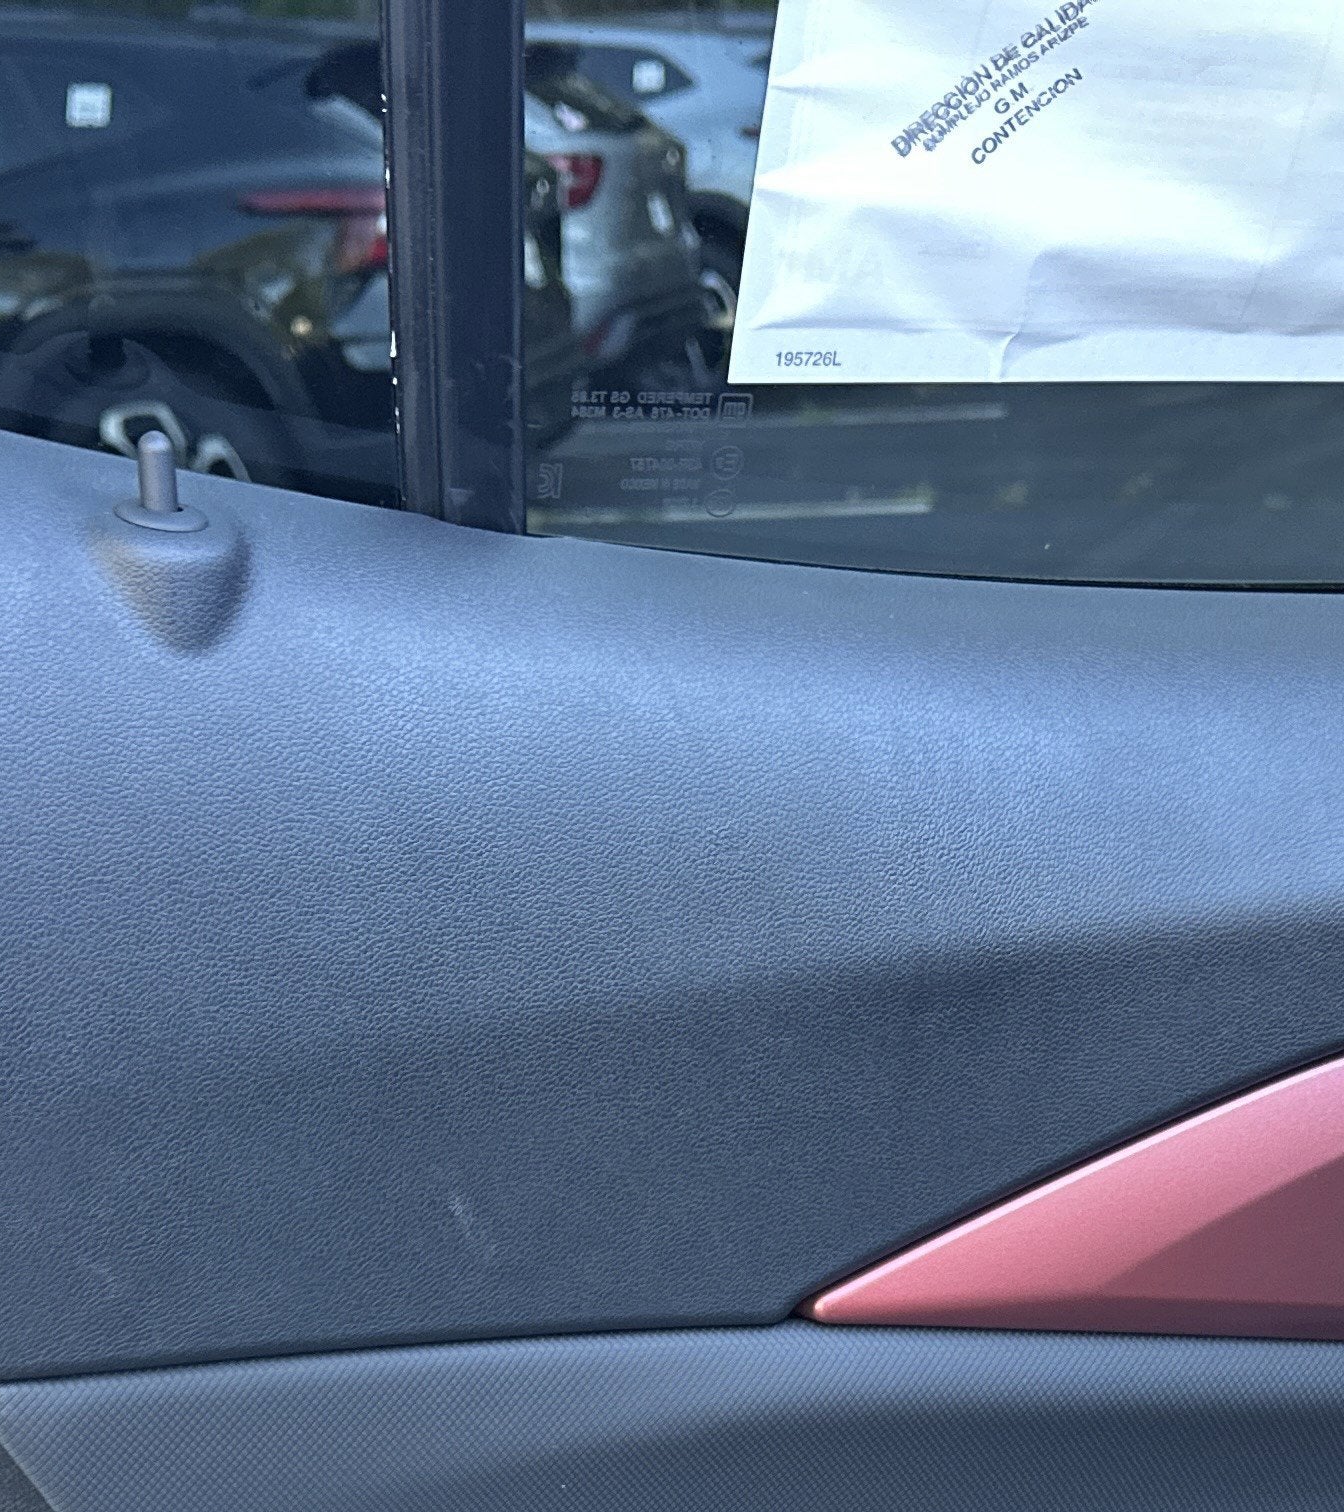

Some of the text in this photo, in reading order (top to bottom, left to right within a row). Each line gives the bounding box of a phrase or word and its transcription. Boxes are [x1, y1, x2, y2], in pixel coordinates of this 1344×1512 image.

[990, 43, 1021, 71] DE
[1021, 0, 1098, 48] CALIDA
[990, 51, 1039, 92] RAMOS
[1040, 16, 1090, 56] ARIZPE
[971, 67, 1083, 165] CONTENCION
[775, 351, 842, 367] 195726L
